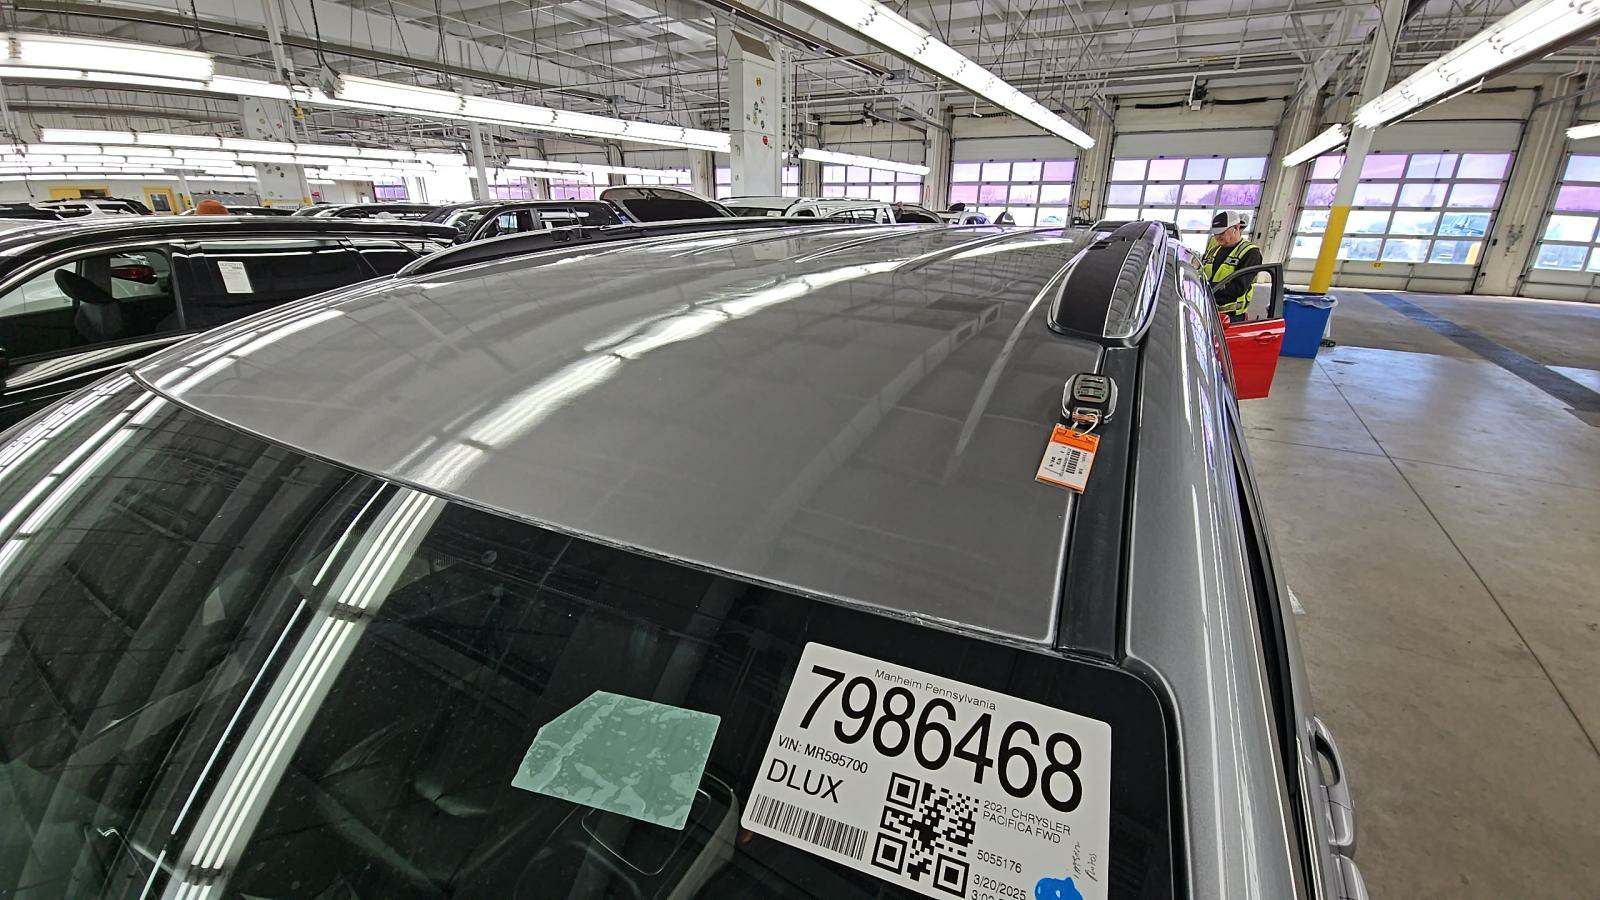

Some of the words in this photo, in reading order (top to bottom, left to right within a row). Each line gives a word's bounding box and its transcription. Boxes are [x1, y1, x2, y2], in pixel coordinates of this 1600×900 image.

[874, 669, 922, 690] Manheim
[925, 682, 996, 711] Pennsylvania
[779, 735, 802, 752] VIN:
[804, 743, 869, 774] MR595700
[799, 665, 1083, 813] 7986468
[766, 757, 845, 804] DLUX
[982, 810, 1033, 836] PACIFICA
[1035, 827, 1061, 844] FWD
[983, 800, 1007, 814] 2021
[1011, 808, 1071, 836] CHRYSLER
[976, 849, 1022, 874] 5055176
[973, 874, 1027, 900] 3/20/2025
